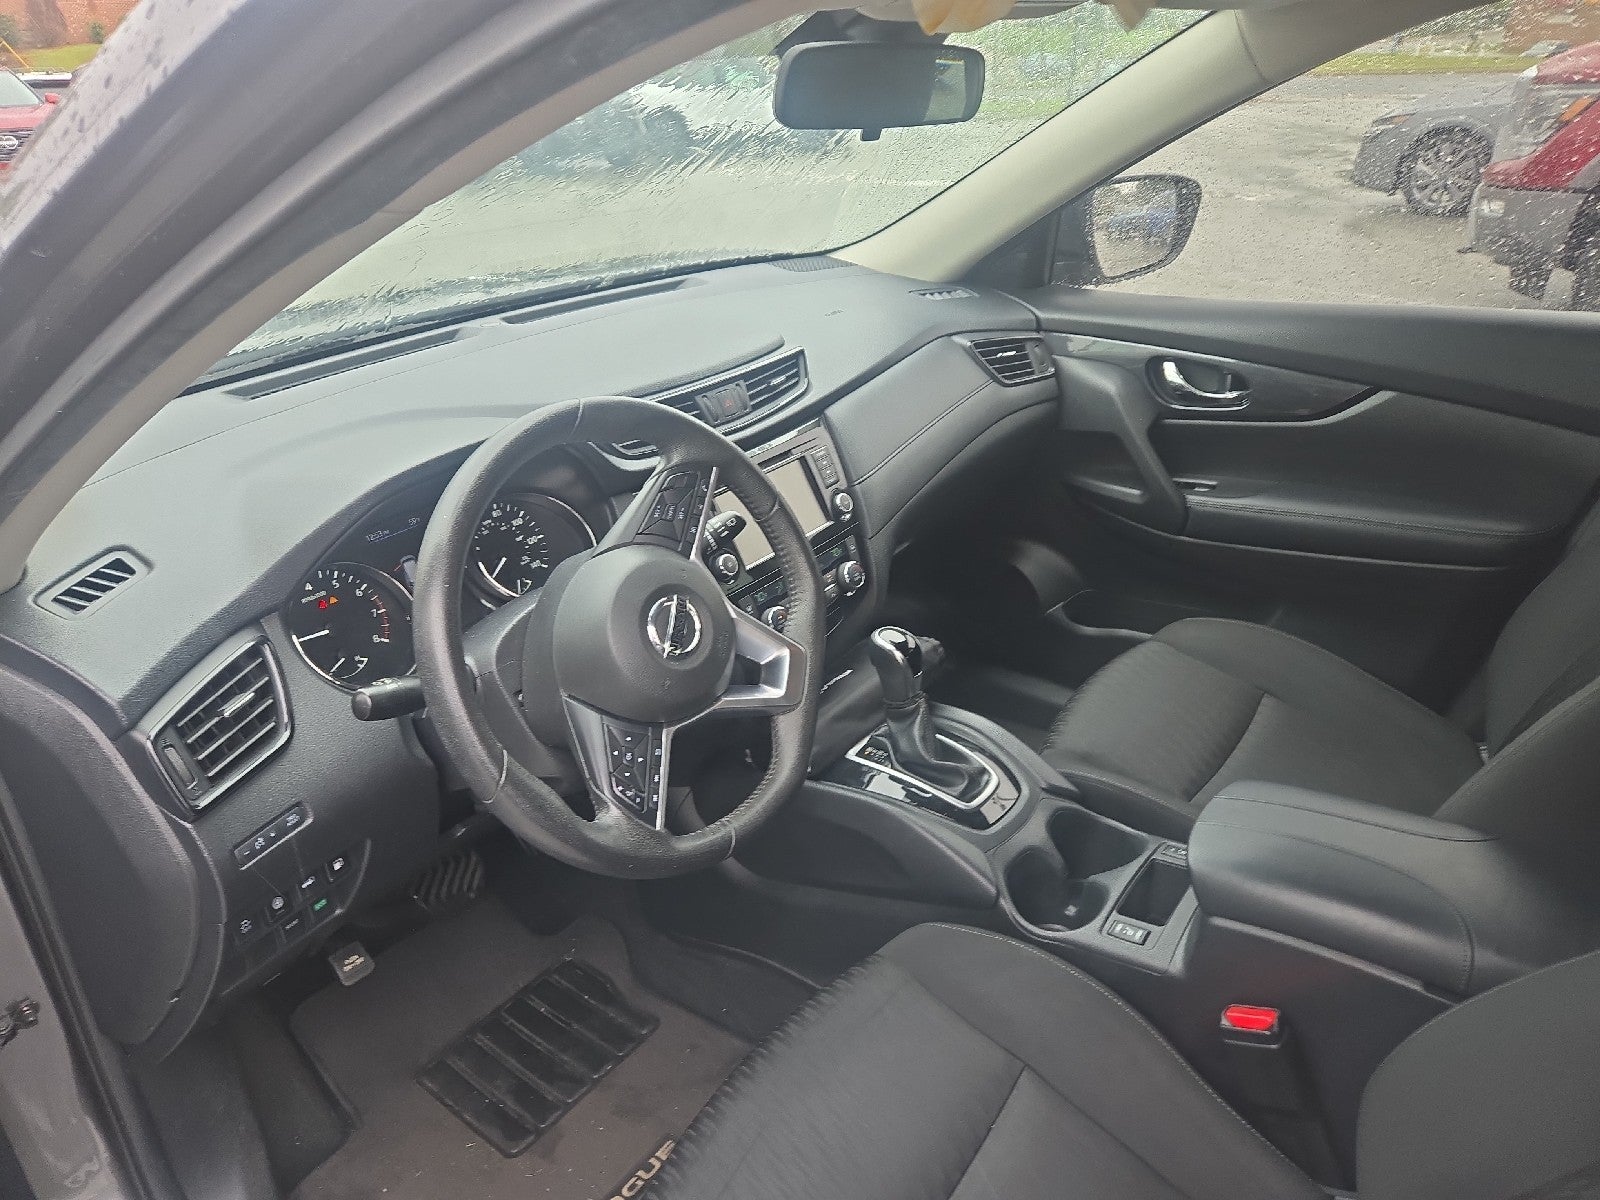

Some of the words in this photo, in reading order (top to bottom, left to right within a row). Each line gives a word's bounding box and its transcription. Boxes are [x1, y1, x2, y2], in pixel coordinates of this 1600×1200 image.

[304, 582, 313, 591] 4
[332, 580, 340, 589] 5
[355, 588, 363, 597] 6
[370, 608, 377, 618] 7
[372, 634, 380, 643] 8
